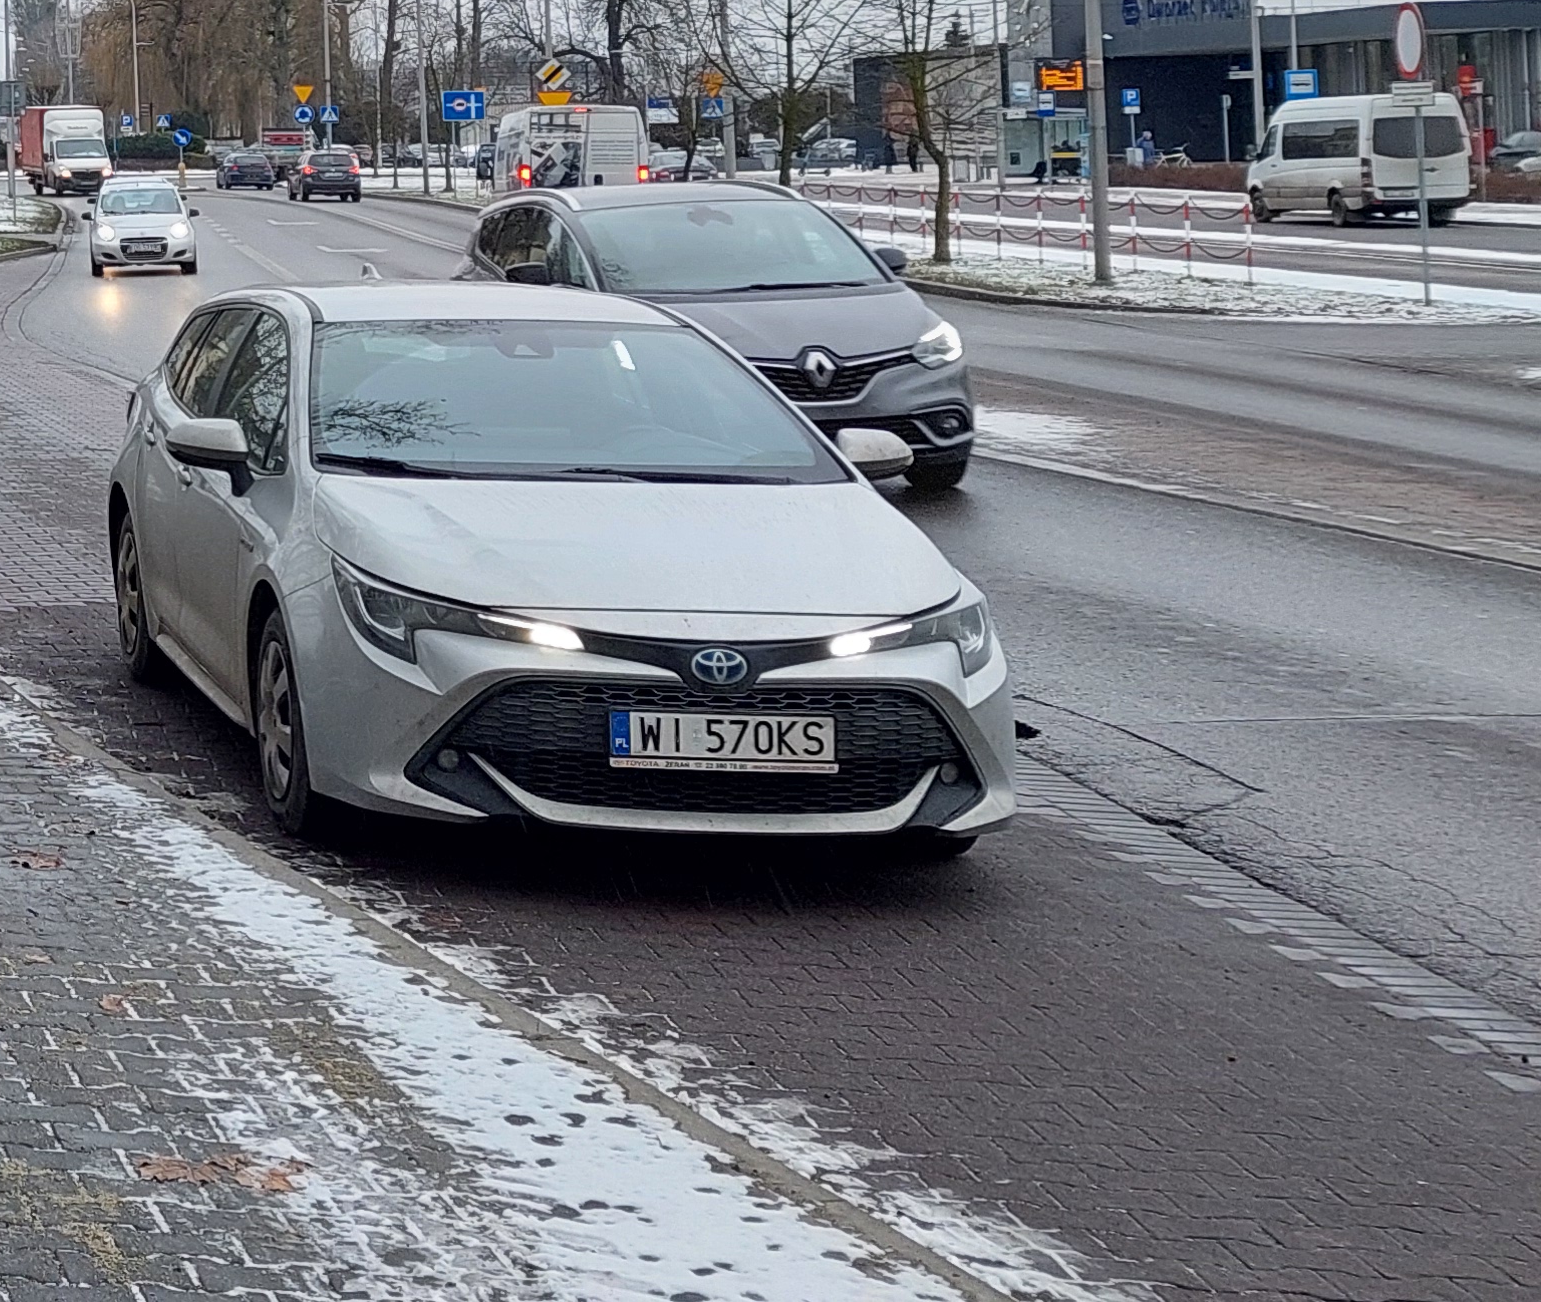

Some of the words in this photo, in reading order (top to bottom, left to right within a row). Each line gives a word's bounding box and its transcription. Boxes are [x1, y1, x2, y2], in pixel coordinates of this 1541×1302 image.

[614, 737, 629, 748] PL
[639, 716, 682, 753] WI
[705, 718, 826, 757] 570KS
[625, 759, 660, 768] TOYOTA
